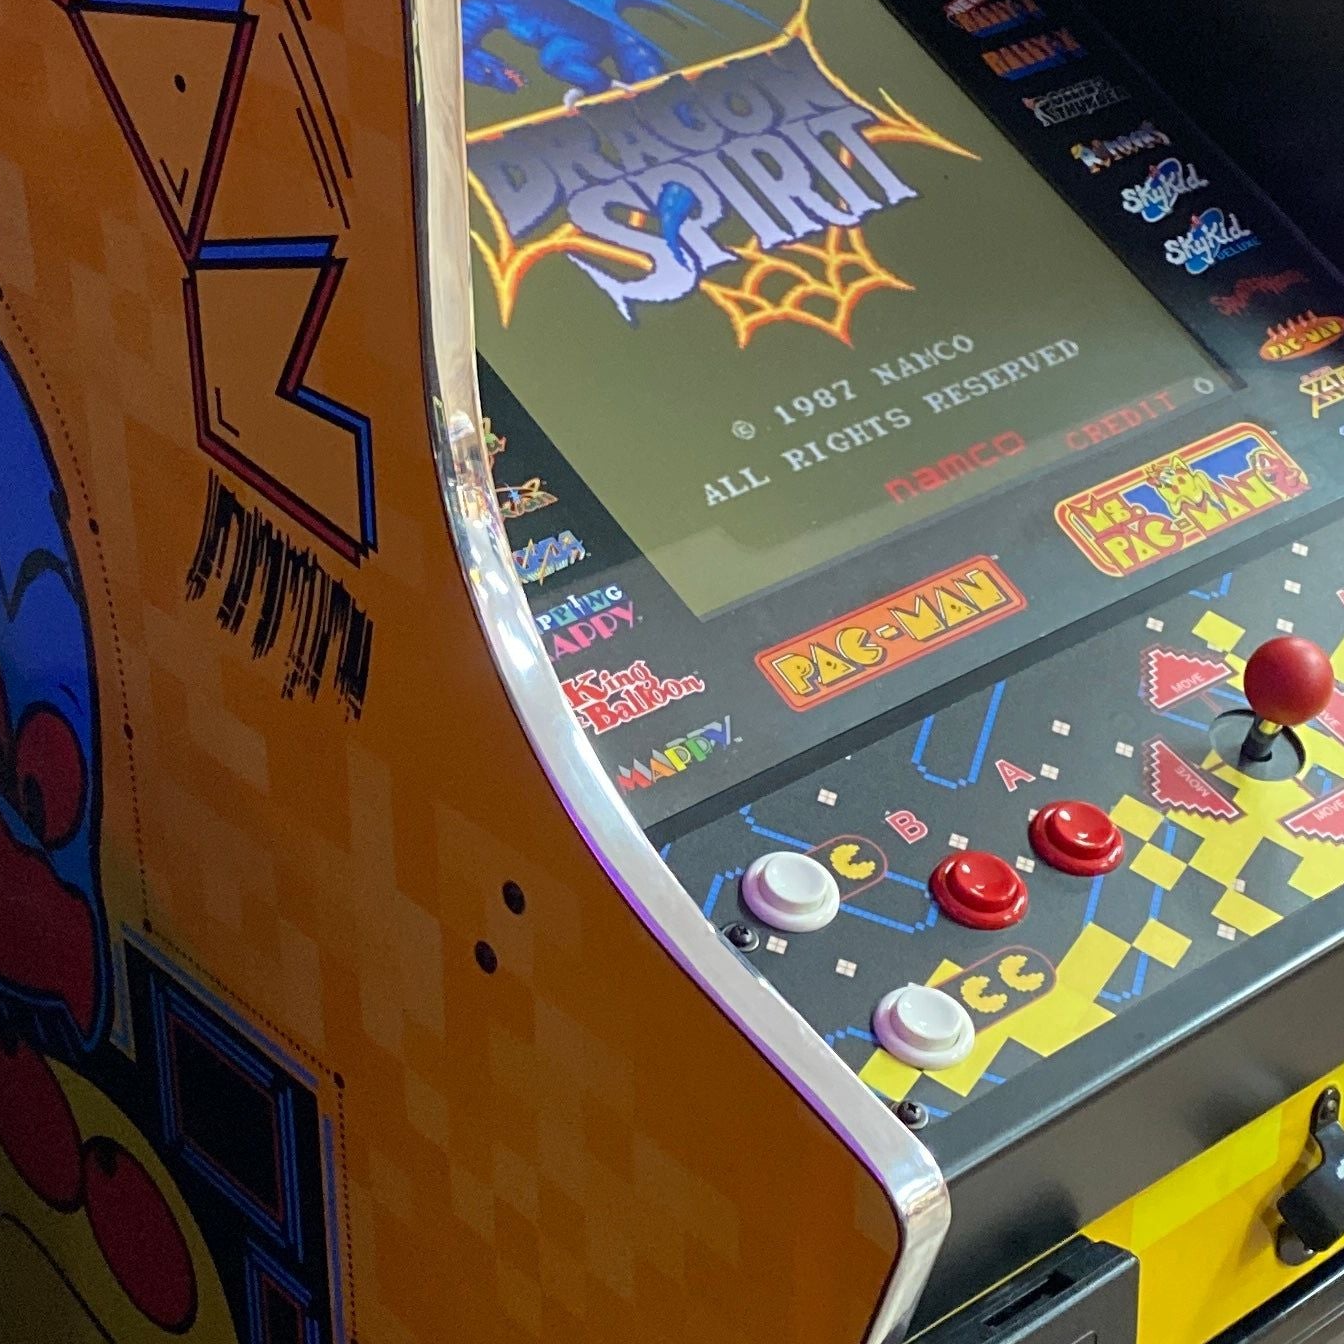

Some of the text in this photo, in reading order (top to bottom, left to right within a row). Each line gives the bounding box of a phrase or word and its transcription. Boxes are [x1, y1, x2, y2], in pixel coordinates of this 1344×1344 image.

[472, 42, 864, 239] DRAGON
[568, 114, 920, 327] SPIRIT
[773, 379, 857, 426] 1987
[870, 334, 975, 387] NAMCO
[703, 338, 1080, 507] ALL RIGHTS RESERVED
[1064, 390, 1178, 452] CREDIT
[884, 430, 1029, 504] namco
[1102, 476, 1280, 570] PAC-MAN
[536, 585, 625, 633] PPING
[548, 599, 636, 664] APPY
[770, 568, 1012, 698] PAC-MAN
[561, 660, 656, 709] King
[583, 673, 706, 735] Balloon
[1171, 673, 1206, 694] MOVE
[616, 714, 733, 795] MAPPY
[995, 759, 1035, 792] A
[1175, 766, 1211, 798] MOVE
[886, 809, 928, 844] B
